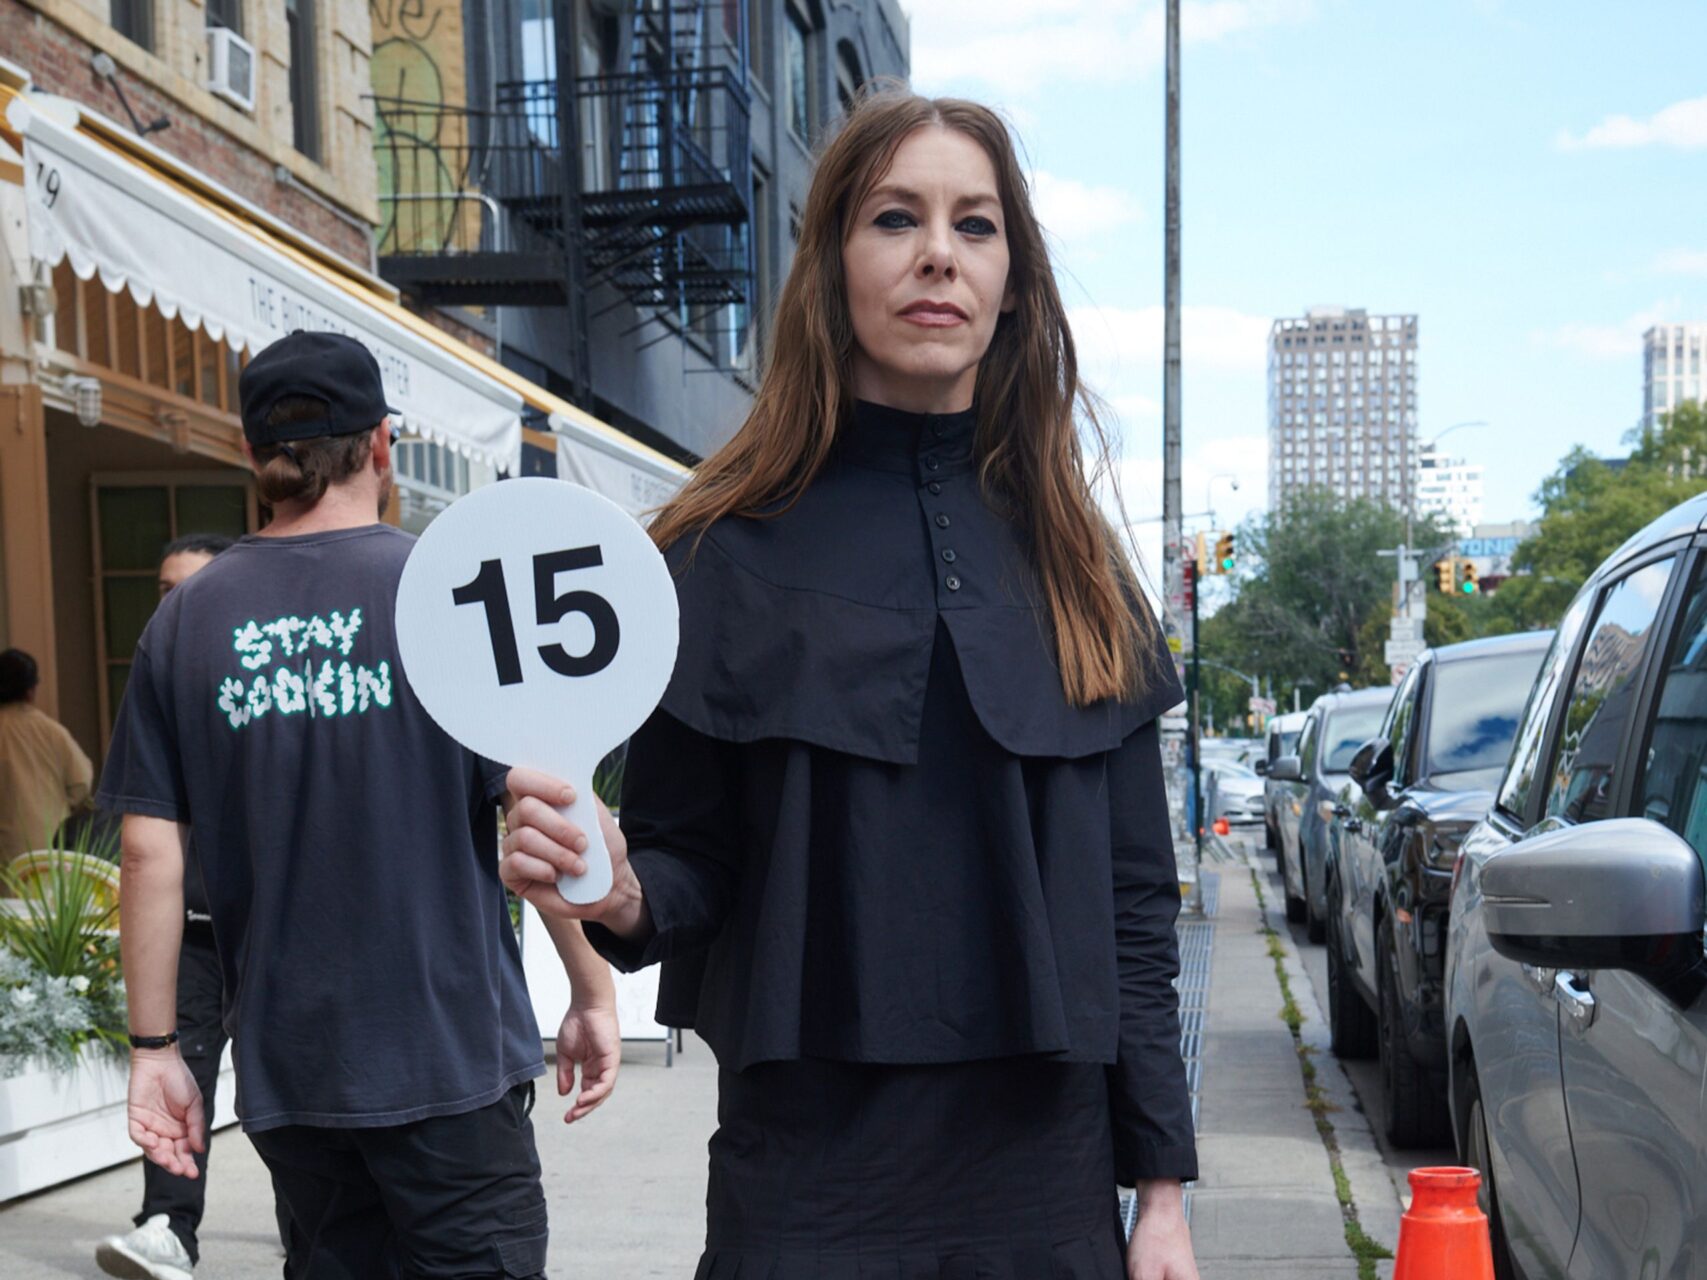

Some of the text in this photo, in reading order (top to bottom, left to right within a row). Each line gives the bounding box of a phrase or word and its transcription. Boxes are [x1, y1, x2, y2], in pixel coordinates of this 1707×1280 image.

[248, 278, 277, 329] THE
[234, 607, 363, 671] STAY
[452, 544, 620, 687] 15
[217, 658, 392, 729] COOKIN
